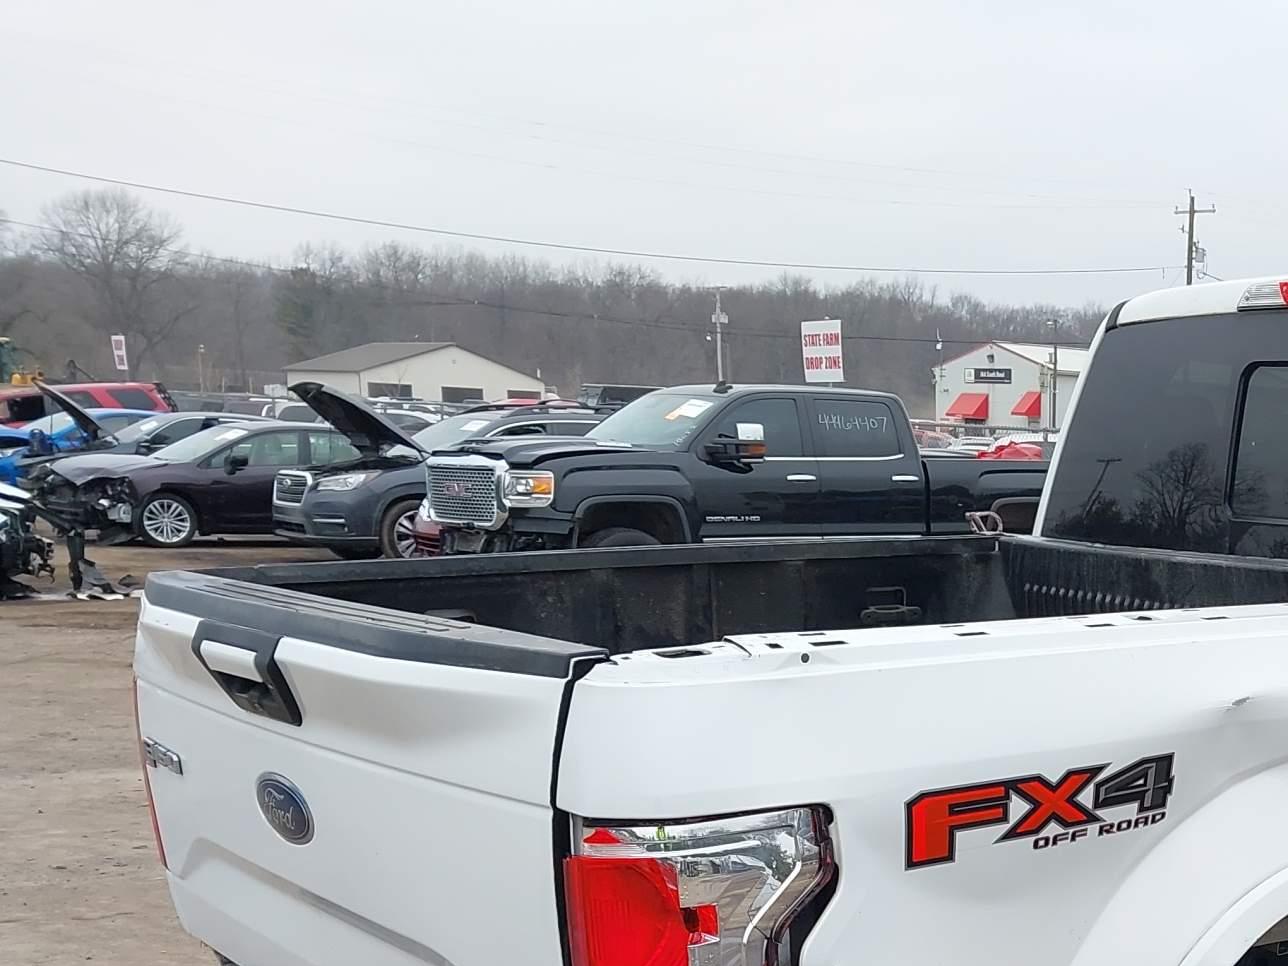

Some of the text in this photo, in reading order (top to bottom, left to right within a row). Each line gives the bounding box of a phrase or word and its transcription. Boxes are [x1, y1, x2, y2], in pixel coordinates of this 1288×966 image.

[803, 332, 841, 348] STATE FARM
[805, 356, 841, 370] DROP ZONE
[263, 787, 297, 830] Ford
[903, 751, 1175, 871] FX4
[1032, 811, 1167, 850] OFF ROAD
